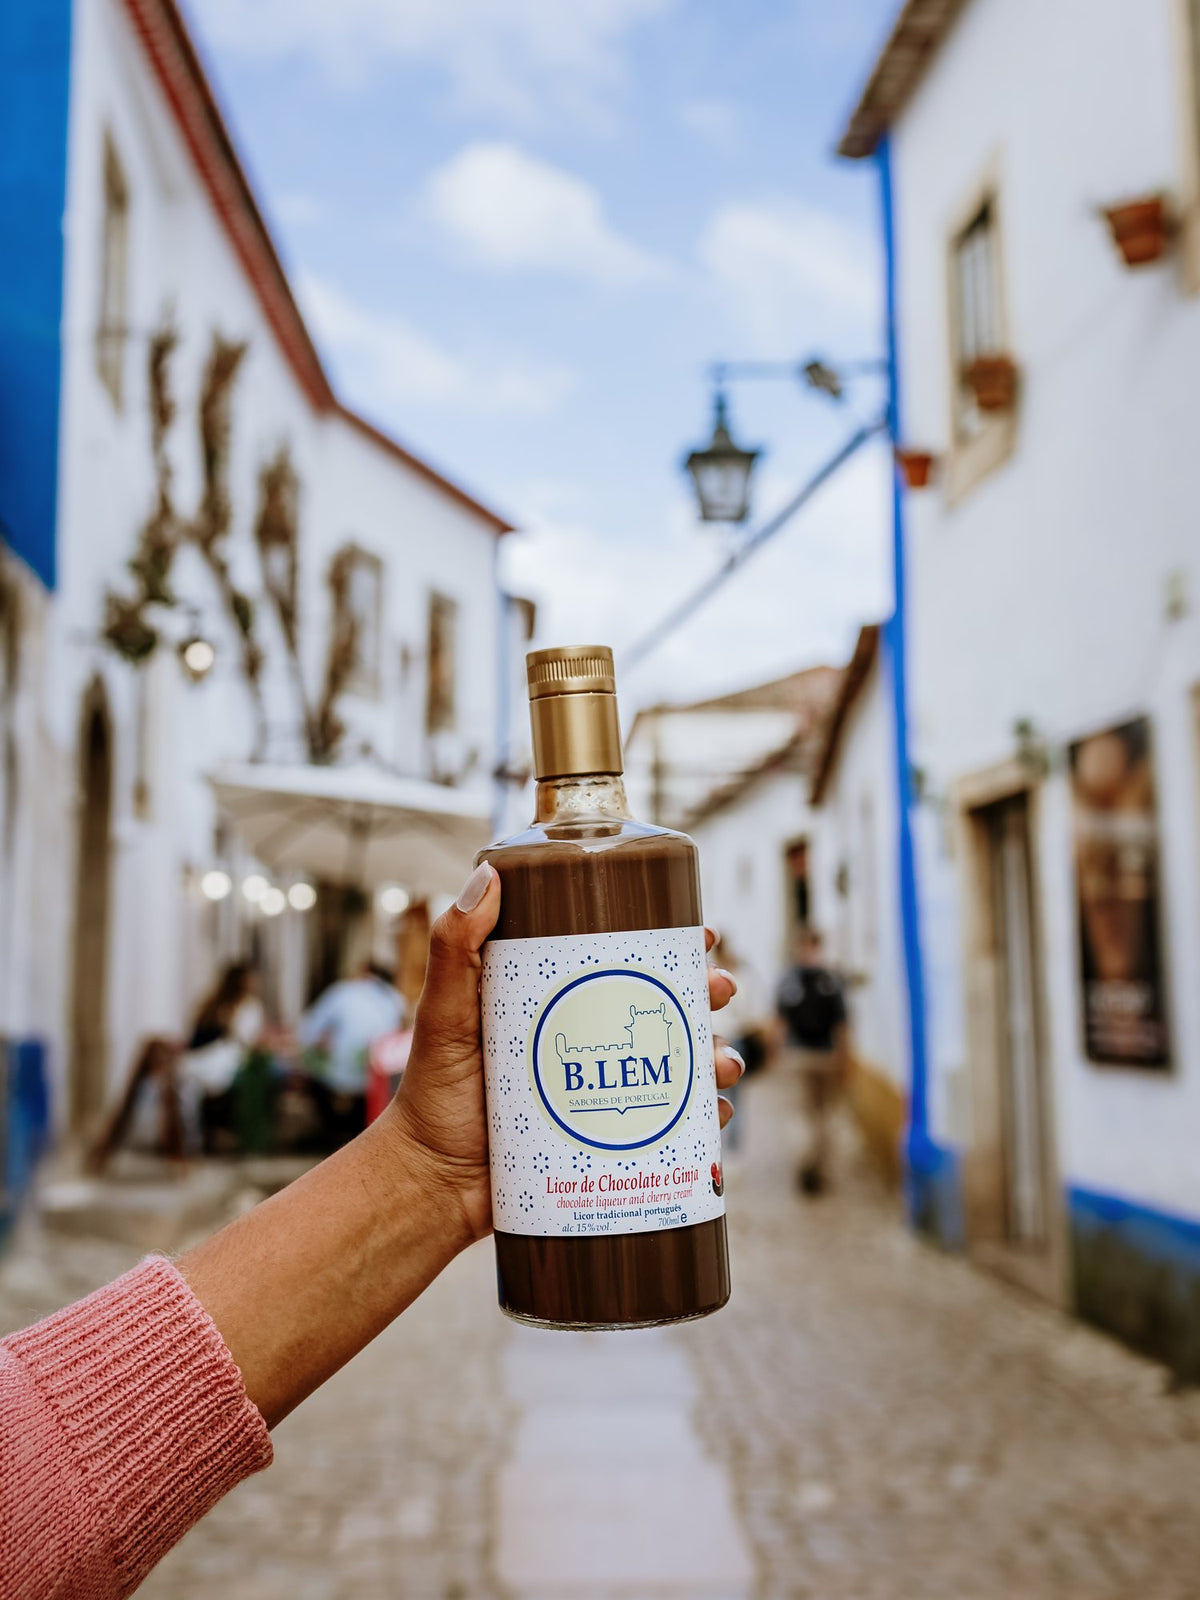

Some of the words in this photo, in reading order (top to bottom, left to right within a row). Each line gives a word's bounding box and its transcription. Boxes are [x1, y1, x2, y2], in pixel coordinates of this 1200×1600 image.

[562, 1055, 673, 1091] B.LÊM
[569, 1096, 609, 1107] SABORES
[610, 1096, 623, 1104] DE
[625, 1092, 670, 1103] PORTUGAL
[546, 1176, 578, 1194] Licor
[580, 1175, 595, 1193] de
[598, 1171, 661, 1192] Chocolate
[664, 1173, 670, 1186] e
[672, 1165, 699, 1188] Ginja
[556, 1195, 594, 1208] chocolate
[596, 1194, 628, 1210] liqueur
[628, 1192, 645, 1205] and
[646, 1190, 672, 1205] cherry
[673, 1189, 693, 1200] cream
[573, 1211, 595, 1221] Licor
[597, 1207, 642, 1220] tradicional
[644, 1203, 682, 1218] português
[562, 1223, 574, 1232] alc
